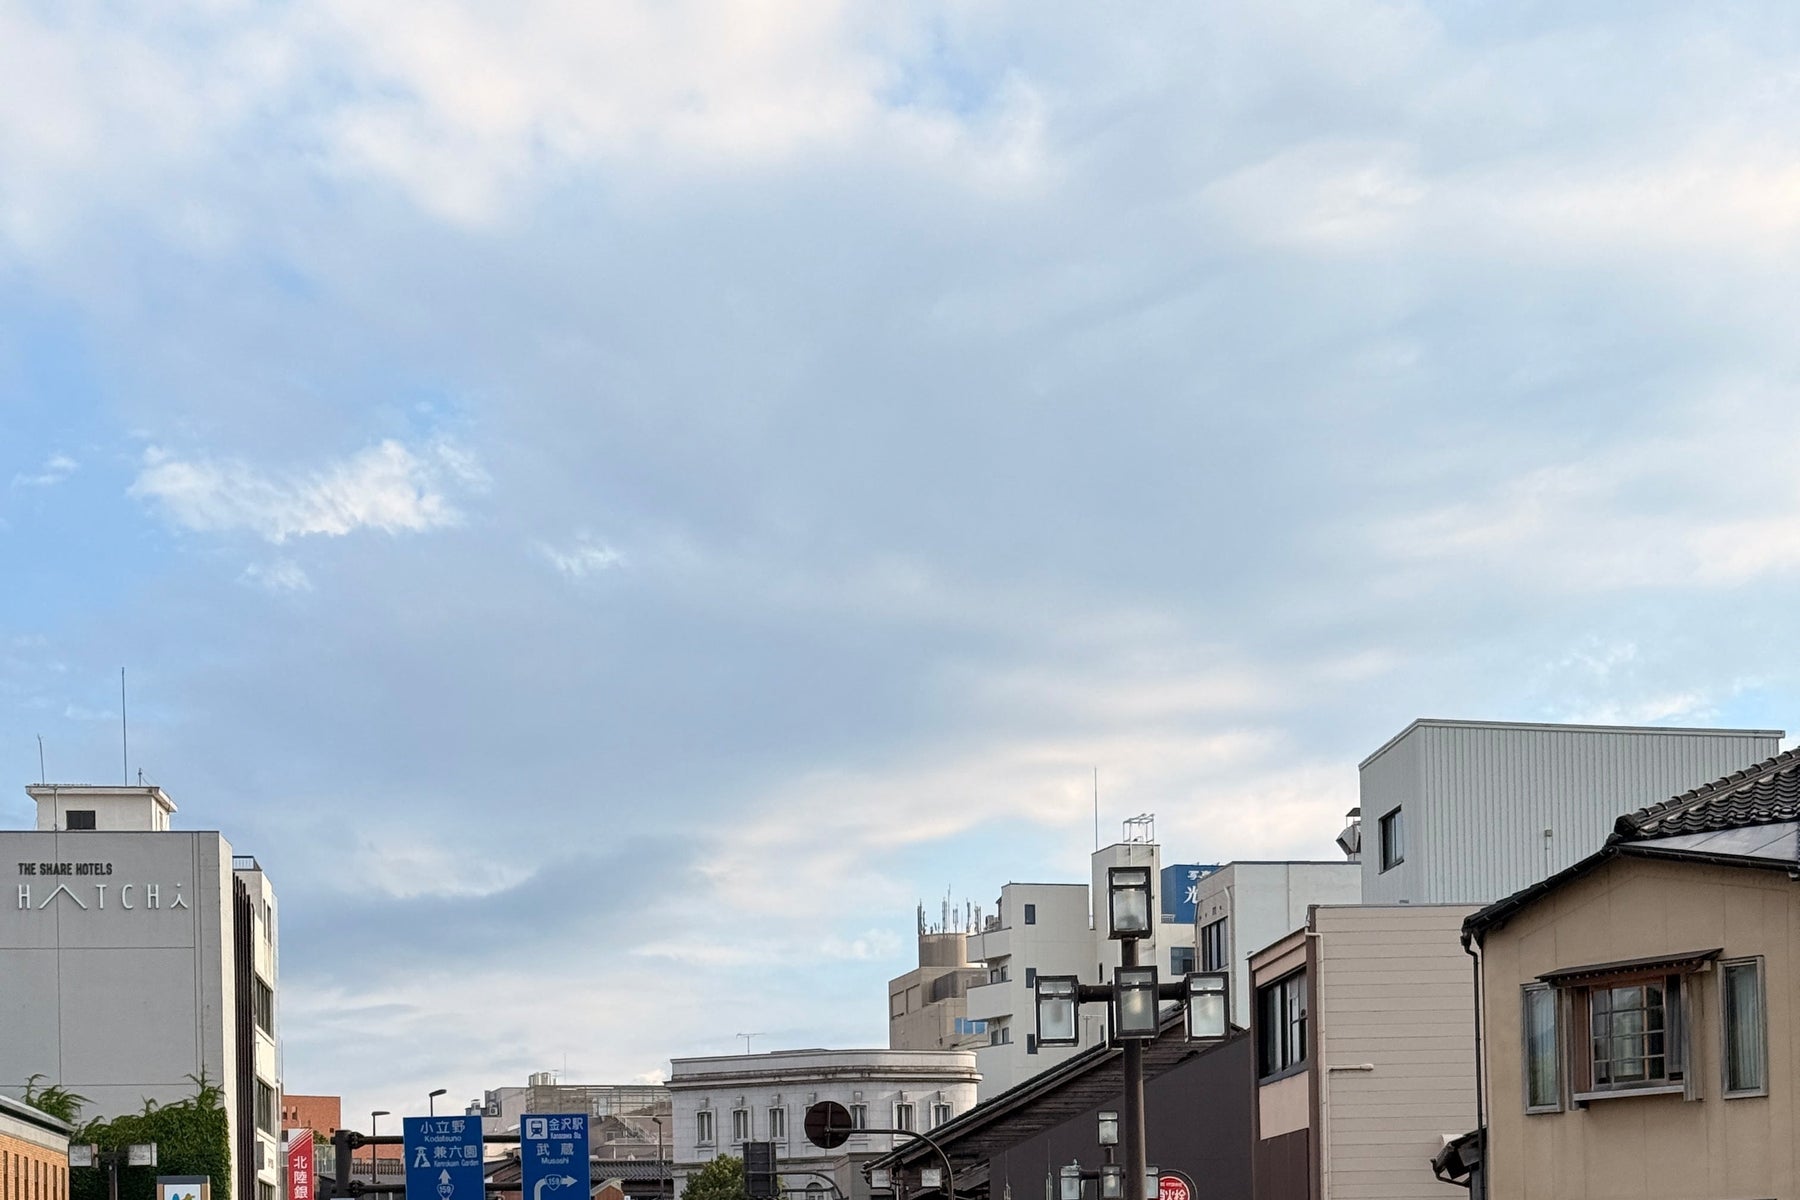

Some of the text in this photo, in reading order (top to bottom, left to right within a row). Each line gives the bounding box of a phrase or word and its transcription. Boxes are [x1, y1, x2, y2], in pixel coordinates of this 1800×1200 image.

[18, 862, 113, 876] THE SHARE HOTELS
[420, 1119, 466, 1134] 小立野
[548, 1117, 584, 1131] 金沢駅
[433, 1145, 478, 1159] 兼六園
[439, 1185, 451, 1194] 159
